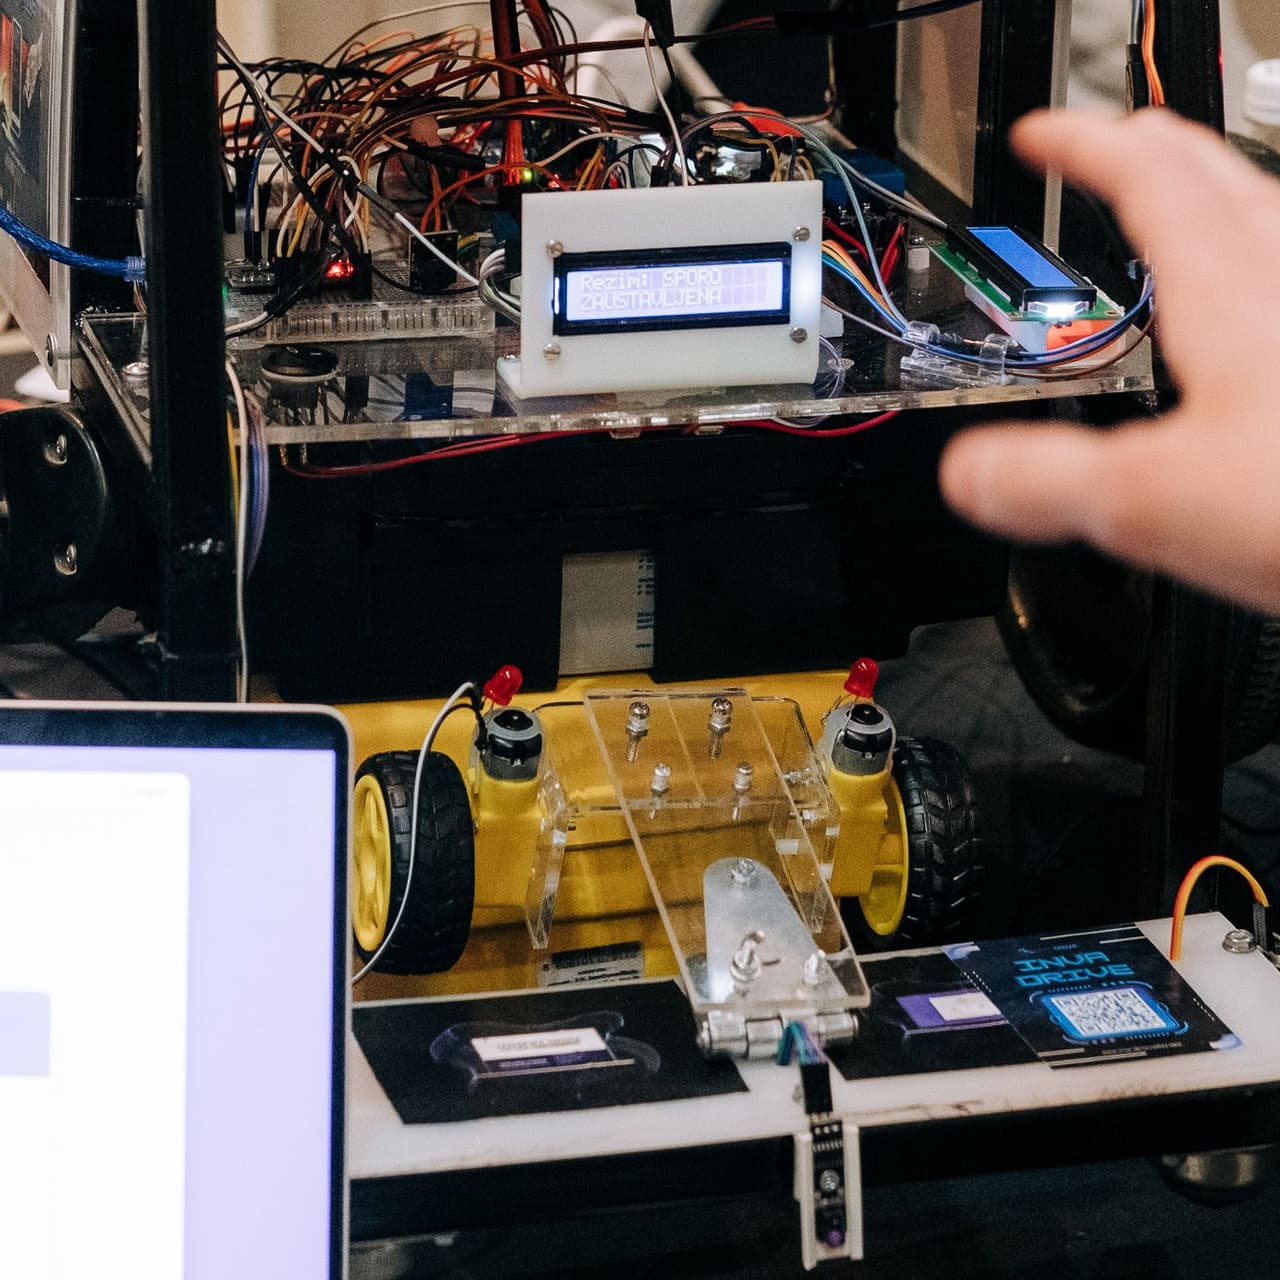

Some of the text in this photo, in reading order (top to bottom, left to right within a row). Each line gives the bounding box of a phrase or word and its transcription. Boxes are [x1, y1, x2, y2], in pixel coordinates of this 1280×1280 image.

[581, 269, 721, 291] Rezim: SPORO
[581, 287, 721, 311] ZAUSTAVLJENA
[1012, 951, 1111, 971] INVA
[1014, 963, 1135, 988] DRIVE
